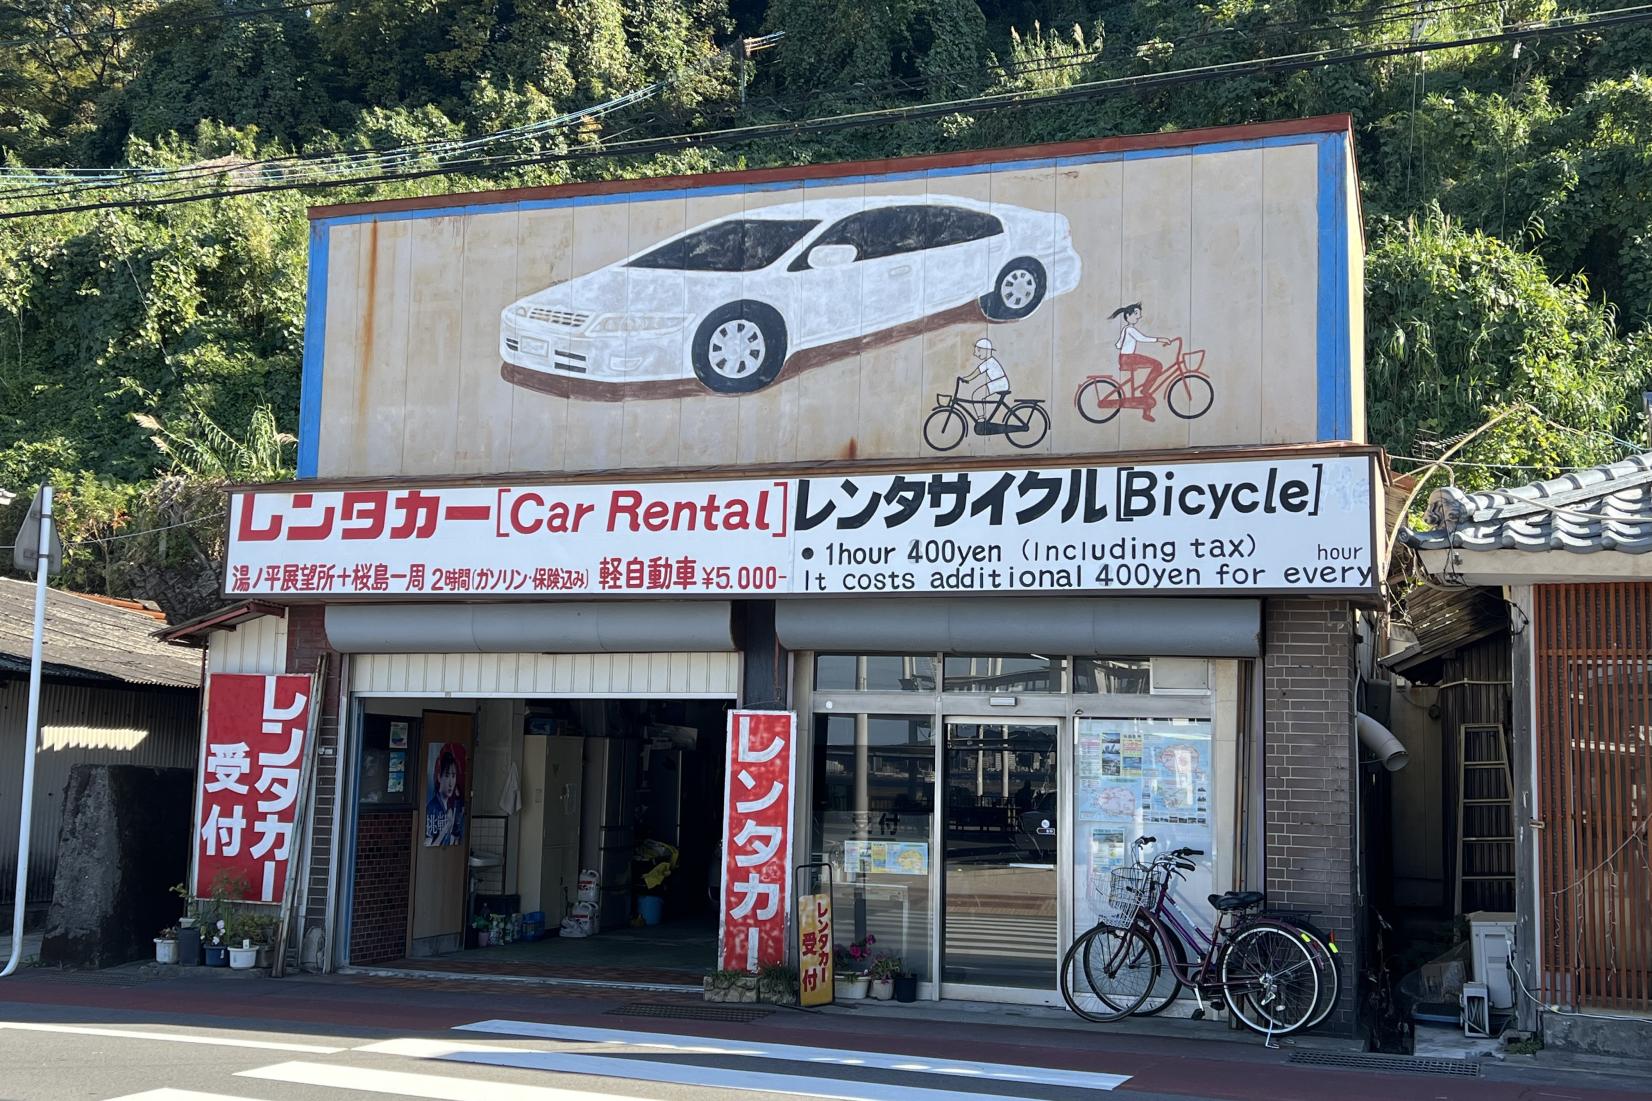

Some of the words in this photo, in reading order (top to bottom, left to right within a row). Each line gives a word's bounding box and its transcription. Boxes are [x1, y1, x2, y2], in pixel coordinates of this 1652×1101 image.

[237, 490, 491, 542] レンタカー
[495, 488, 595, 538] [Car
[606, 481, 788, 538] Rental]
[794, 469, 1108, 531] レンタサイクル
[1115, 463, 1324, 523] [Bicycle]
[804, 569, 828, 592] It
[842, 570, 916, 591] costs
[929, 564, 1083, 590] additional
[1094, 562, 1202, 588] 400yen
[1215, 563, 1267, 586] for
[1283, 565, 1372, 587] every
[825, 541, 897, 566] 1hour
[907, 538, 1002, 567] 400yen
[1022, 536, 1176, 563] (Including
[1189, 533, 1257, 559] tax)
[1317, 543, 1364, 561] hour
[200, 741, 251, 857] 受付
[249, 675, 308, 902] レンタカー
[729, 716, 786, 975] レンタカー
[802, 931, 819, 993] 受付
[817, 901, 830, 984] レンタカー
